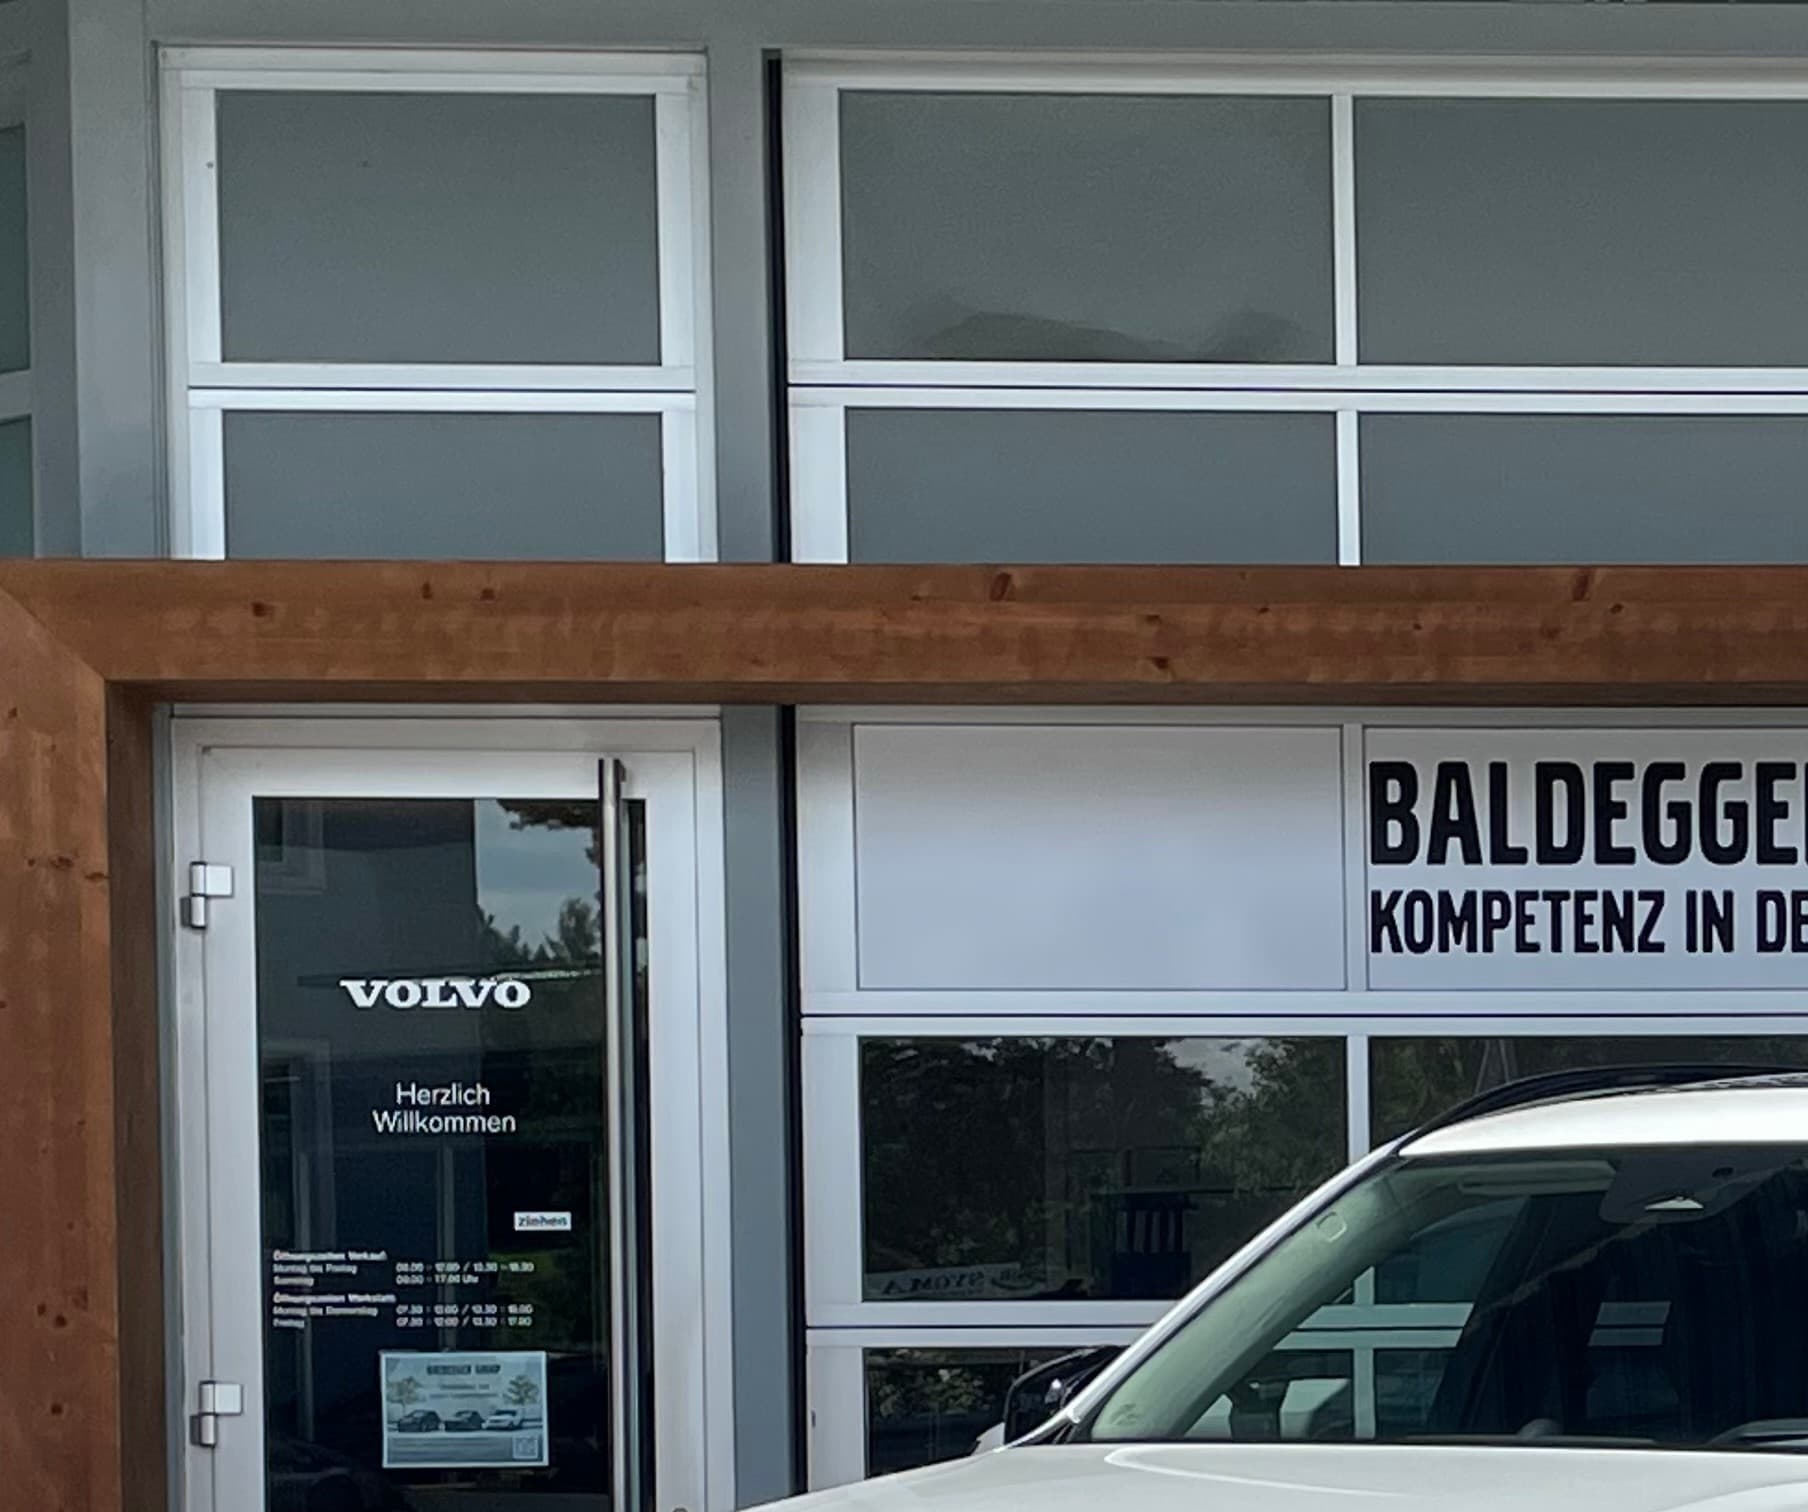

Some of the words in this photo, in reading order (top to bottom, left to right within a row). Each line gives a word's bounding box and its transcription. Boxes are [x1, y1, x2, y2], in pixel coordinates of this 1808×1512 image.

[1370, 889, 1665, 954] KOMPETENZ
[1686, 889, 1734, 953] IN
[340, 979, 532, 1009] VOLVO
[396, 1082, 491, 1105] Herzlich
[371, 1110, 517, 1133] Willkommen
